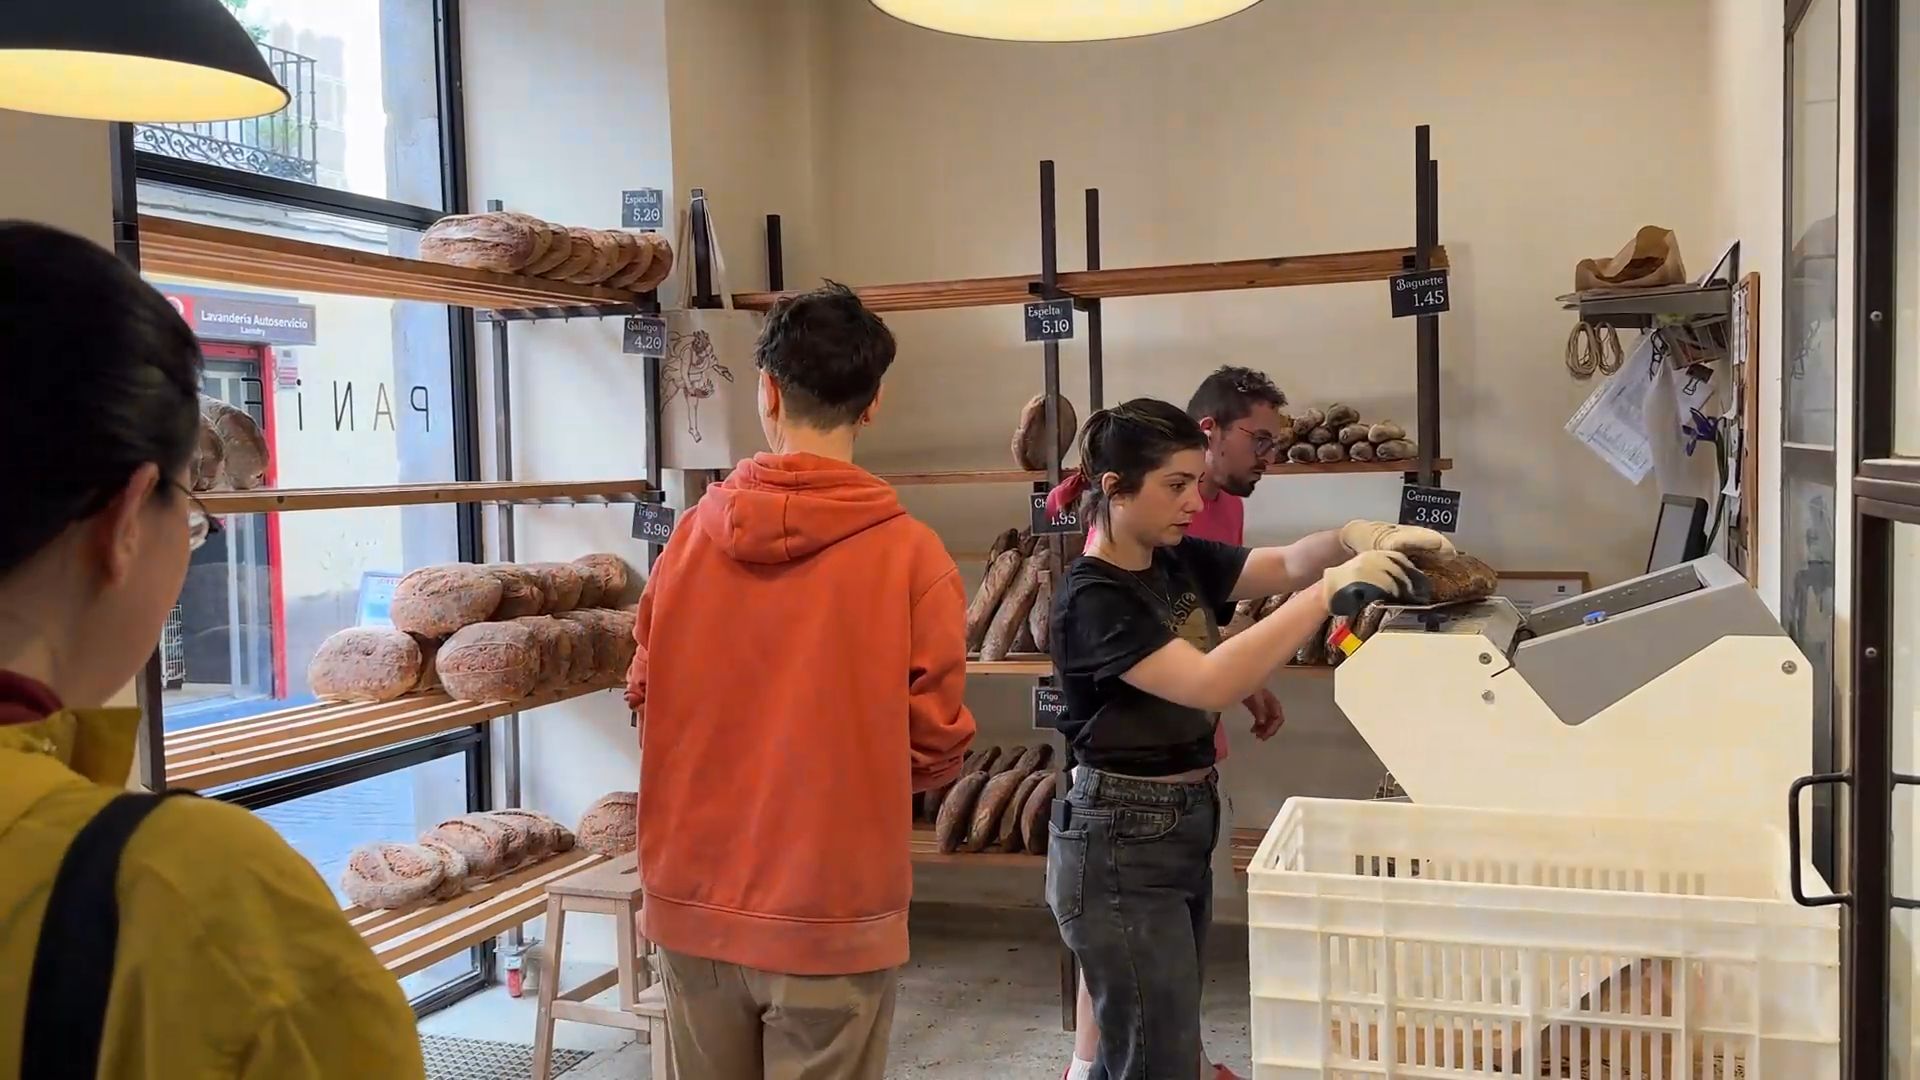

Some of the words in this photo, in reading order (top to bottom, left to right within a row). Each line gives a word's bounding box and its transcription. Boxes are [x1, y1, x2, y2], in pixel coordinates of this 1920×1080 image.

[625, 193, 657, 206] Especial
[1396, 277, 1444, 291] Baguette
[1413, 290, 1445, 307] 1.45
[1028, 304, 1061, 320] Espelta
[254, 315, 308, 329] Autoservicio
[627, 320, 658, 334] Gallego
[1042, 319, 1069, 334] 5.10
[634, 335, 662, 350] 4.20
[1406, 489, 1451, 505] Centeno
[1051, 511, 1077, 526] 1.95
[1416, 507, 1452, 525] 3.80
[643, 521, 670, 537] 3.90
[1038, 691, 1059, 702] Trigo
